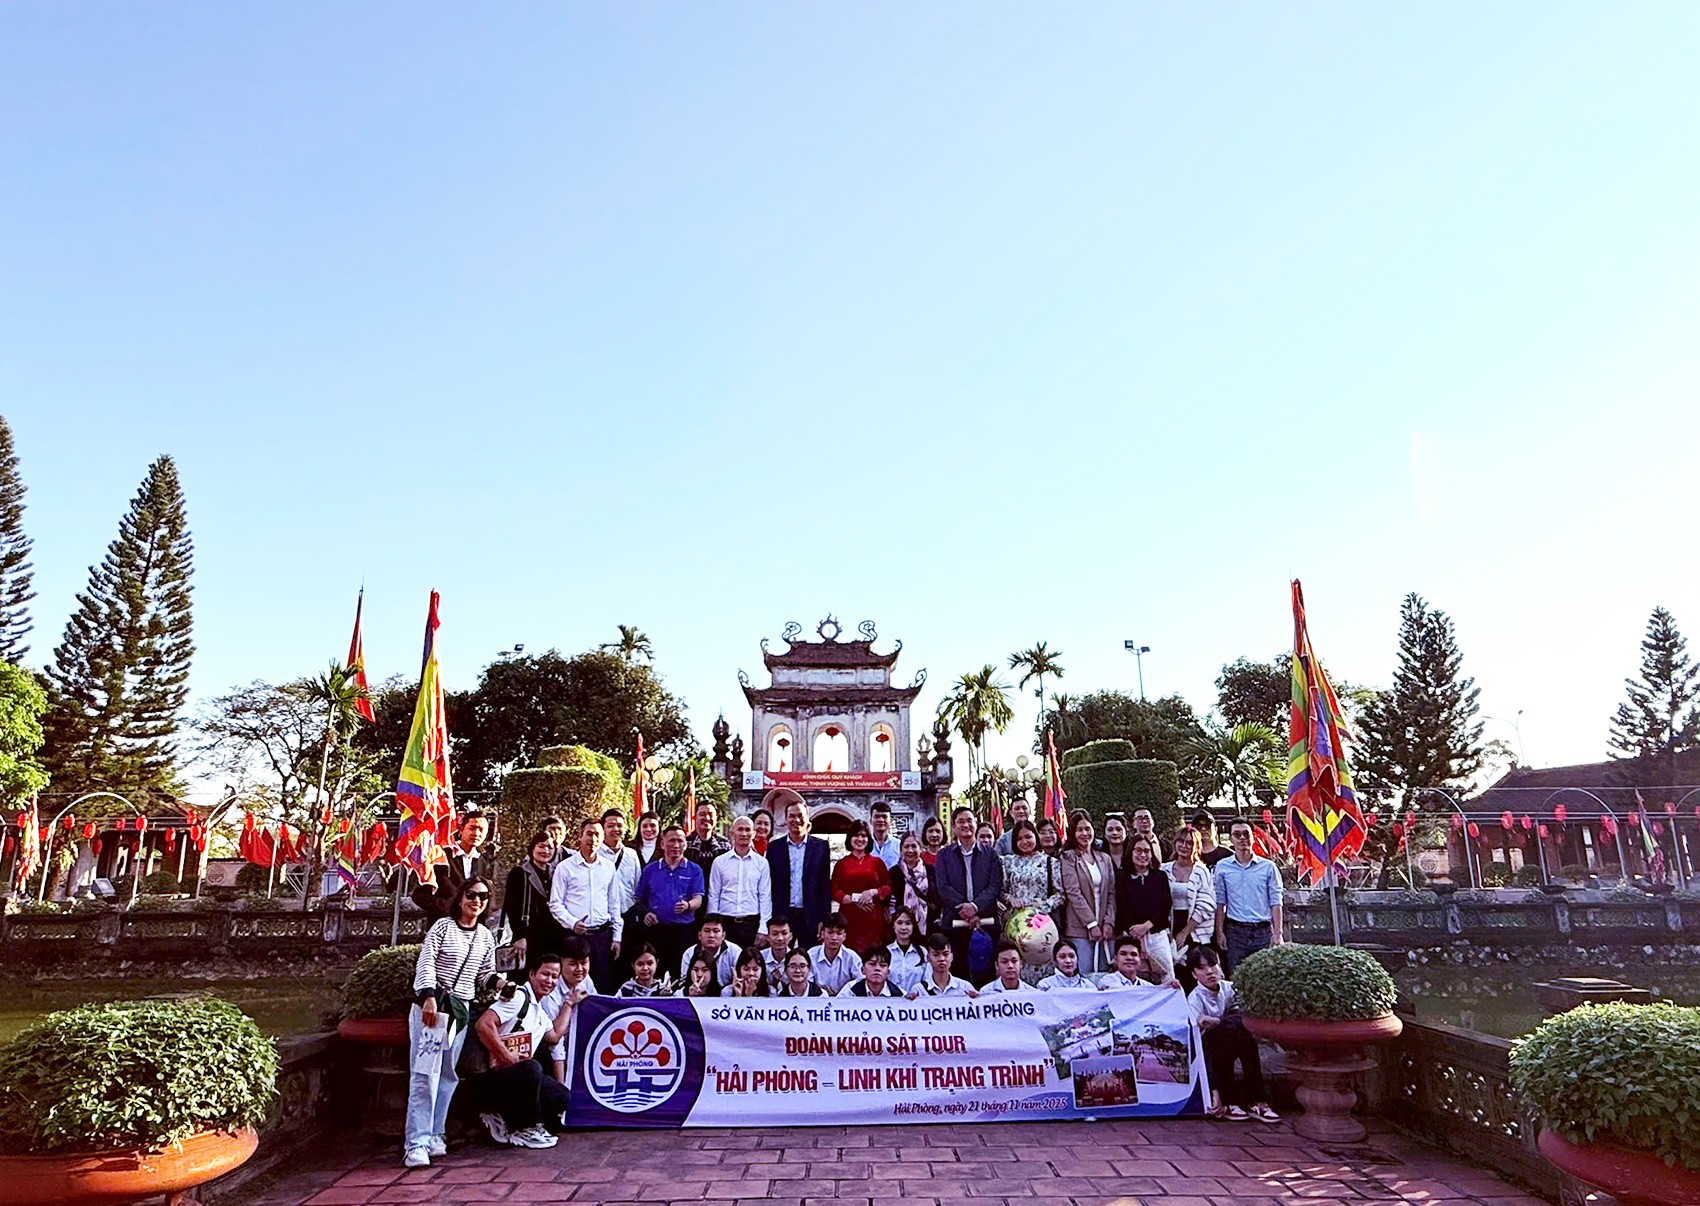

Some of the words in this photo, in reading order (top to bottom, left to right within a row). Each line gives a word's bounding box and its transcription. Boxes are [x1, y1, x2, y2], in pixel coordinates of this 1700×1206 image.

[711, 1004, 731, 1020] SỞ
[735, 1005, 764, 1021] VĂN
[807, 1002, 833, 1021] THỂ
[834, 1009, 872, 1021] THAO
[876, 1006, 895, 1021] VÀ
[898, 1009, 917, 1021] DU
[922, 1008, 951, 1025] LỊCH
[983, 999, 1035, 1019] PHÒNG
[785, 1033, 833, 1055] ĐOÀN
[837, 1031, 883, 1055] KHẢO
[887, 1033, 918, 1054] SÁT
[922, 1035, 967, 1053] TOUR
[753, 1065, 818, 1092] PHÒNG
[838, 1069, 882, 1091] LINH
[886, 1063, 918, 1089] KHÍ
[922, 1066, 985, 1094] TRẠNG
[944, 1101, 967, 1115] ngày
[968, 1101, 980, 1112] 21
[981, 1100, 1007, 1112] tháng
[1043, 1098, 1068, 1109] 2025
